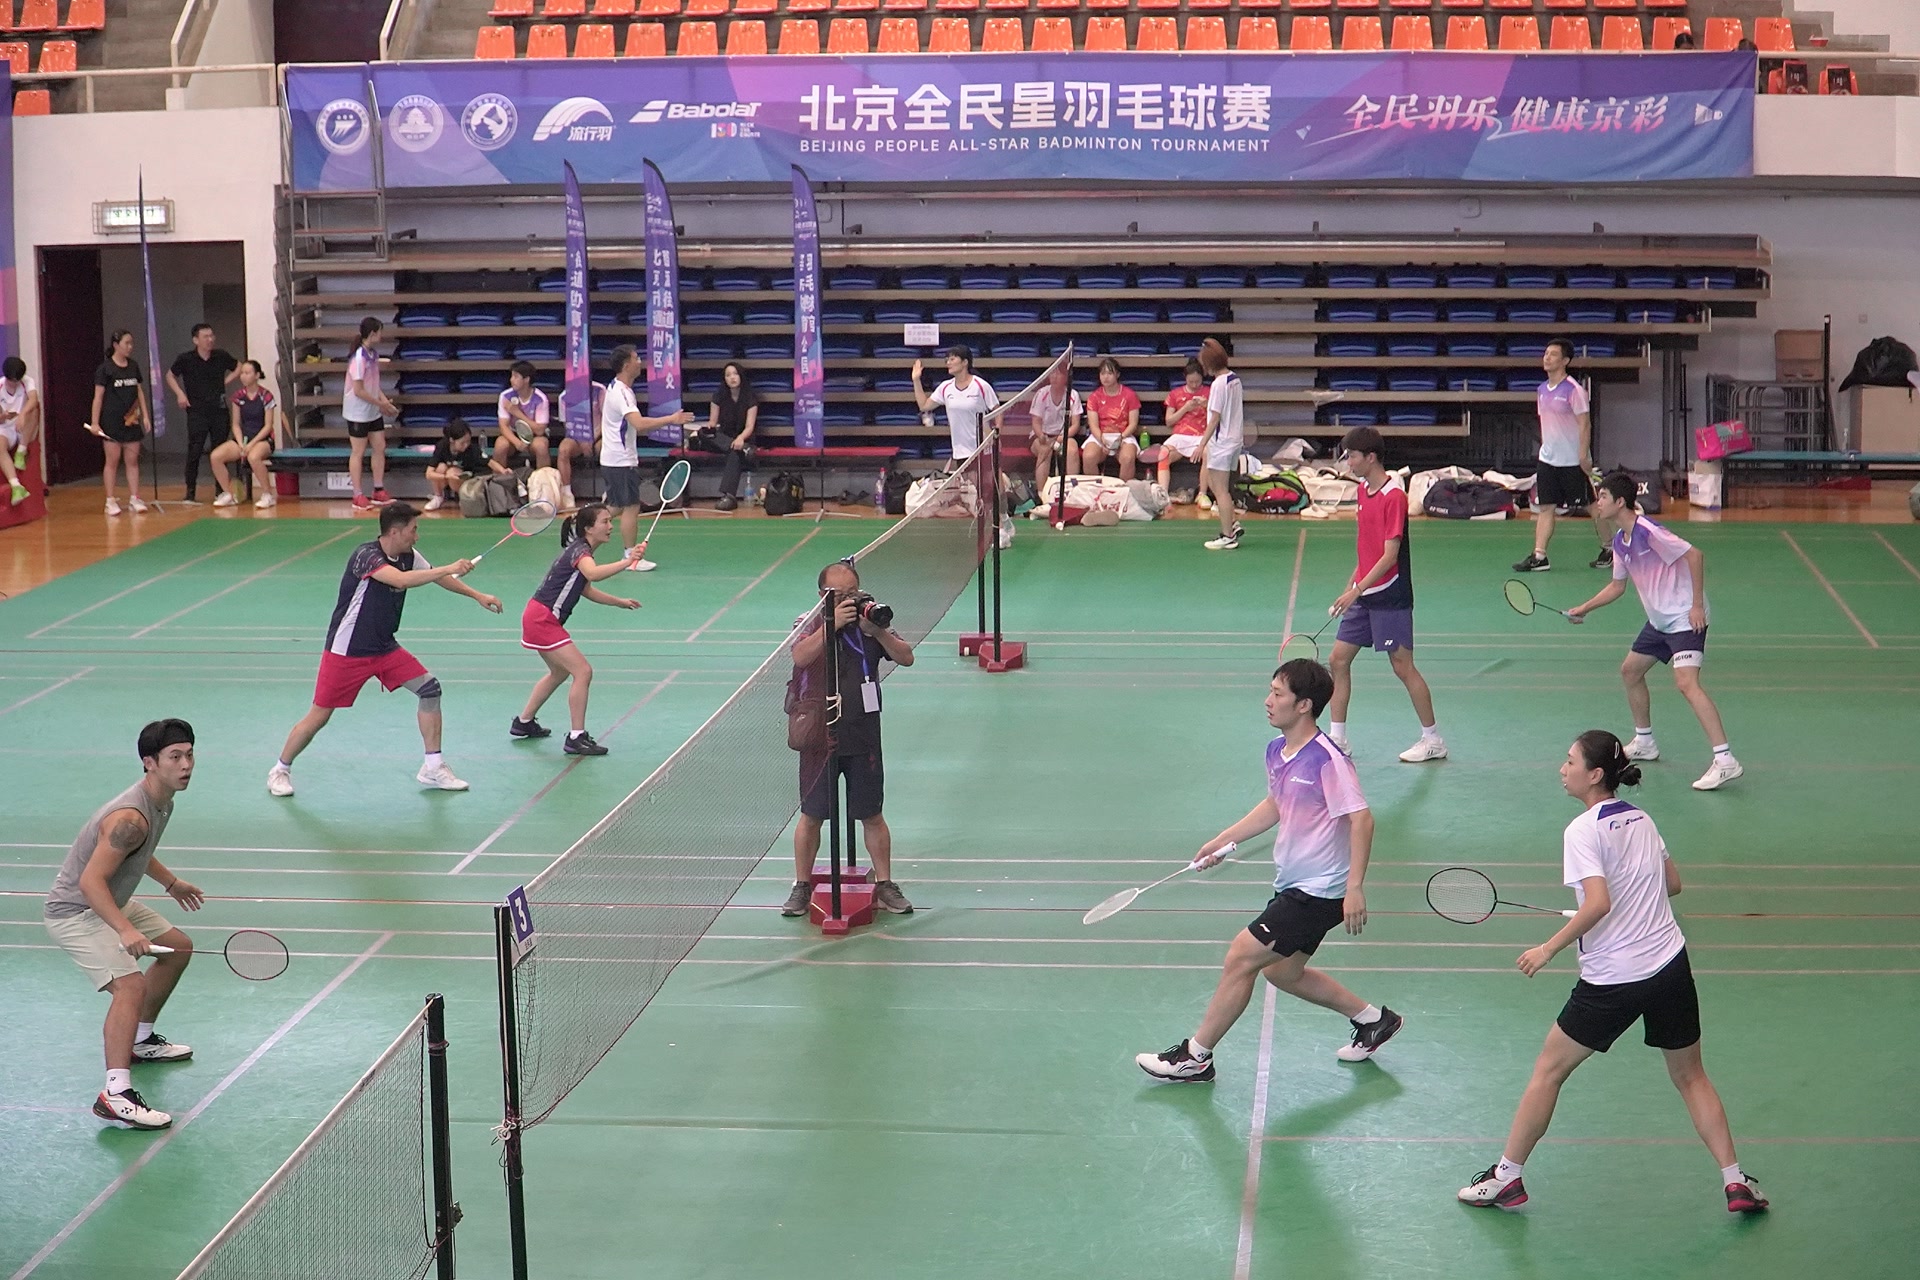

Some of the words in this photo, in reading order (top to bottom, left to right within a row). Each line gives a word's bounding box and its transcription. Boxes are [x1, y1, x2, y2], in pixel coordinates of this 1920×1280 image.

[798, 81, 1273, 132] 北京全民星羽毛球赛
[1343, 94, 1498, 132] 全民羽乐
[1510, 95, 1669, 133] 健康京彩
[567, 126, 613, 141] 流行羽
[800, 139, 866, 153] BEIJING
[875, 139, 940, 152] PEOPLE
[948, 138, 1030, 151] ALL-STAR
[1039, 136, 1142, 151] BADMINTON
[1151, 138, 1271, 152] TOURNAMENT
[514, 896, 527, 932] 3
